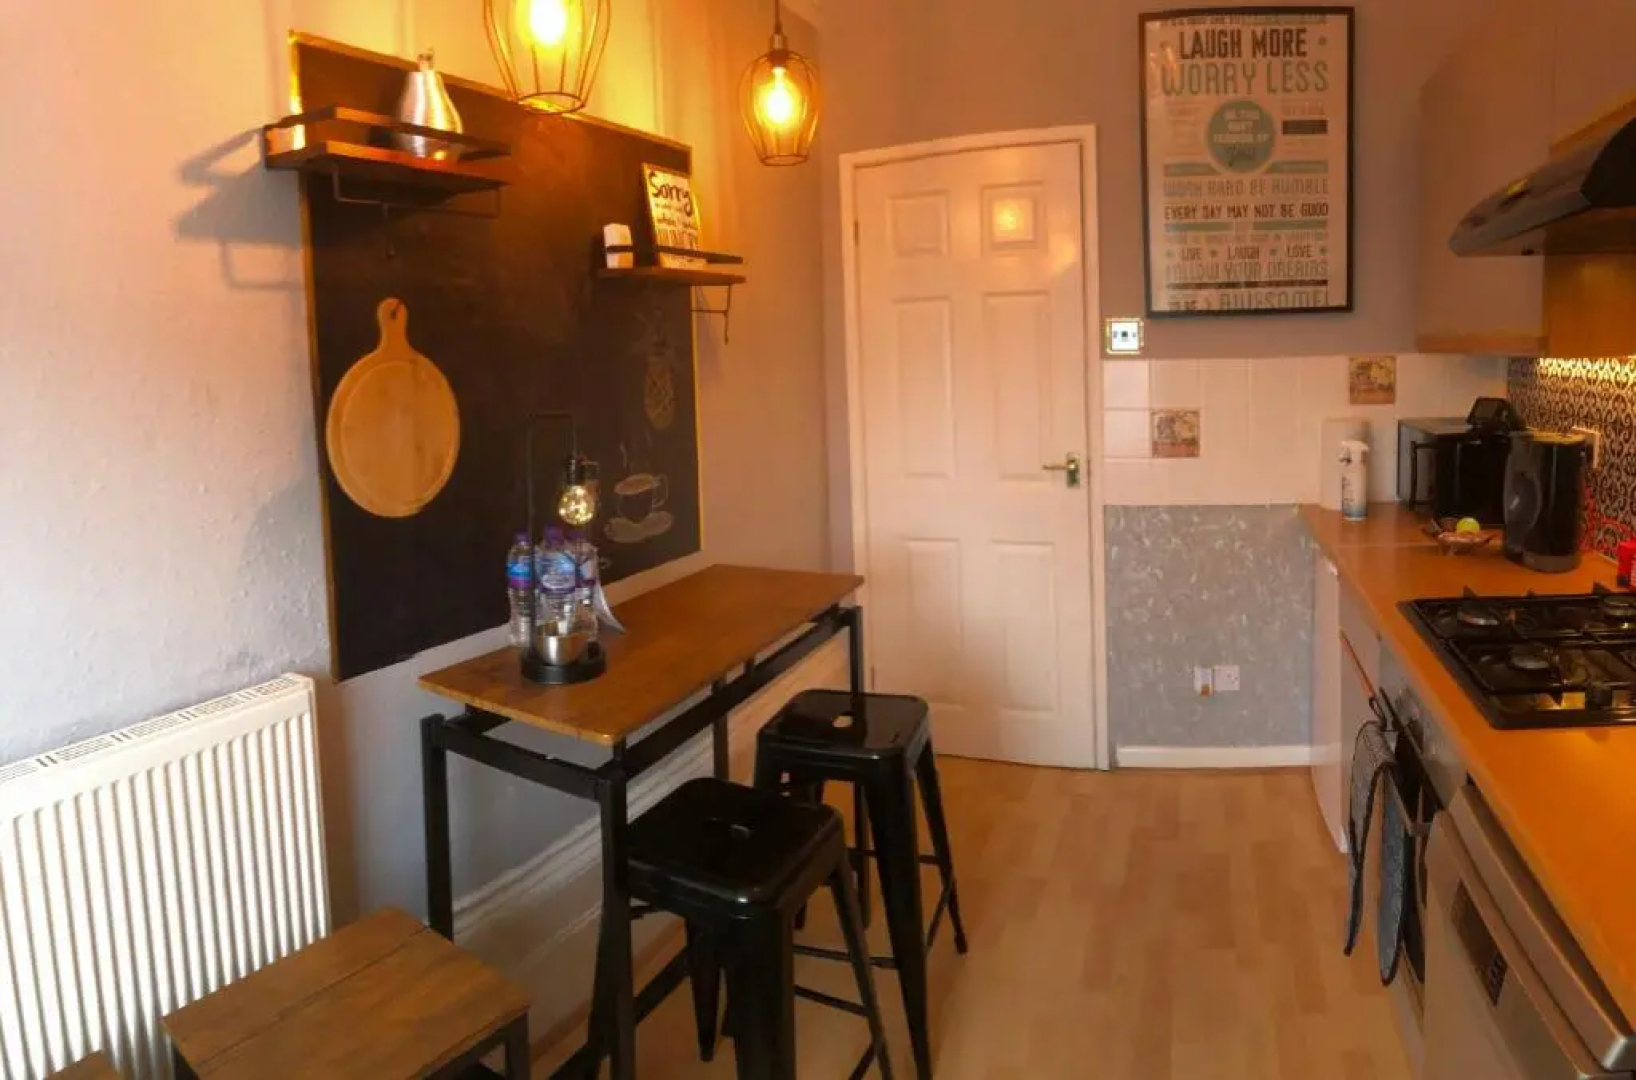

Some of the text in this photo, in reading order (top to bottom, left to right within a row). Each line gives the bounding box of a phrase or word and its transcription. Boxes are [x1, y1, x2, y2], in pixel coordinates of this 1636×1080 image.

[1179, 28, 1307, 59] LAUGH MORE
[1161, 61, 1328, 96] WORRY LESS
[649, 170, 693, 217] Sorry
[1271, 178, 1329, 195] HUMBLE
[1165, 202, 1329, 220] EVERY DAY MAY NOT BE GOOD
[1286, 244, 1312, 259] LOVE
